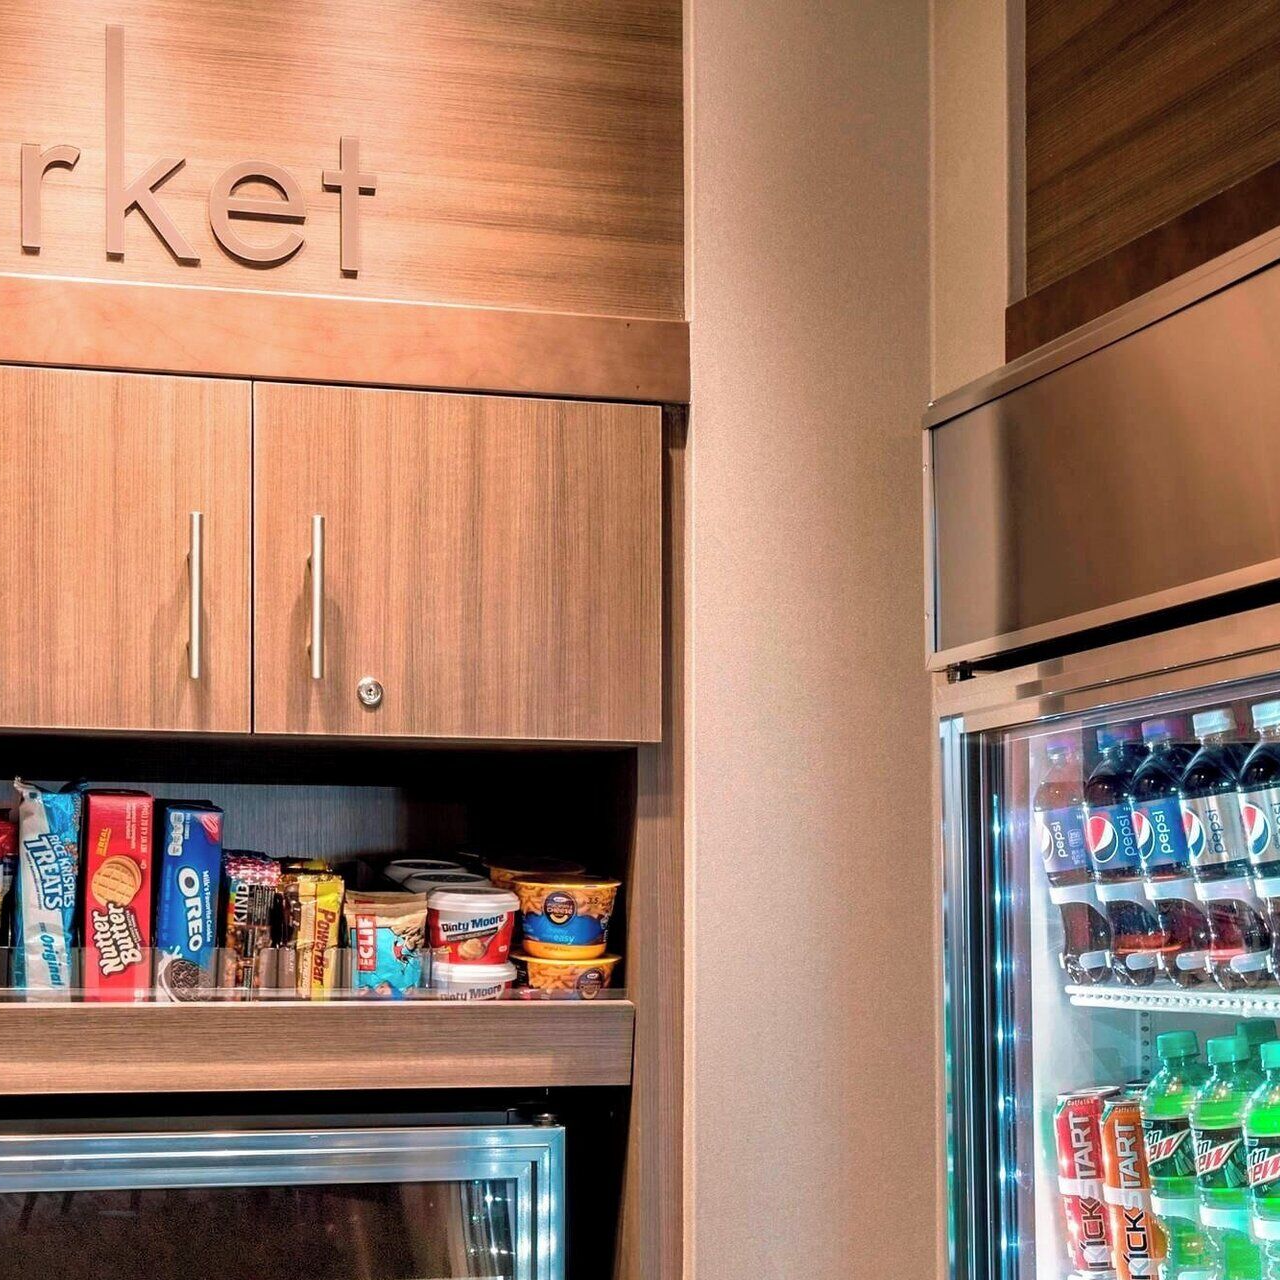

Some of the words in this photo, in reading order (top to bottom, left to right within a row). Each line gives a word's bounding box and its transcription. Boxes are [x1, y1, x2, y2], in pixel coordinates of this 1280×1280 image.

[49, 834, 66, 861] RICE
[1055, 820, 1069, 859] pepsi
[1123, 813, 1137, 858] pepsi
[1160, 810, 1174, 854] pepsi
[23, 835, 63, 911] TREATS
[57, 858, 76, 909] KRISPIES
[178, 867, 203, 952] OREO
[234, 883, 249, 926] KIND
[441, 921, 469, 933] Dinty
[471, 914, 505, 929] Moore
[93, 909, 125, 976] Nutter
[107, 902, 143, 966] Butter
[359, 917, 373, 959] CLIF
[40, 933, 64, 988] Original
